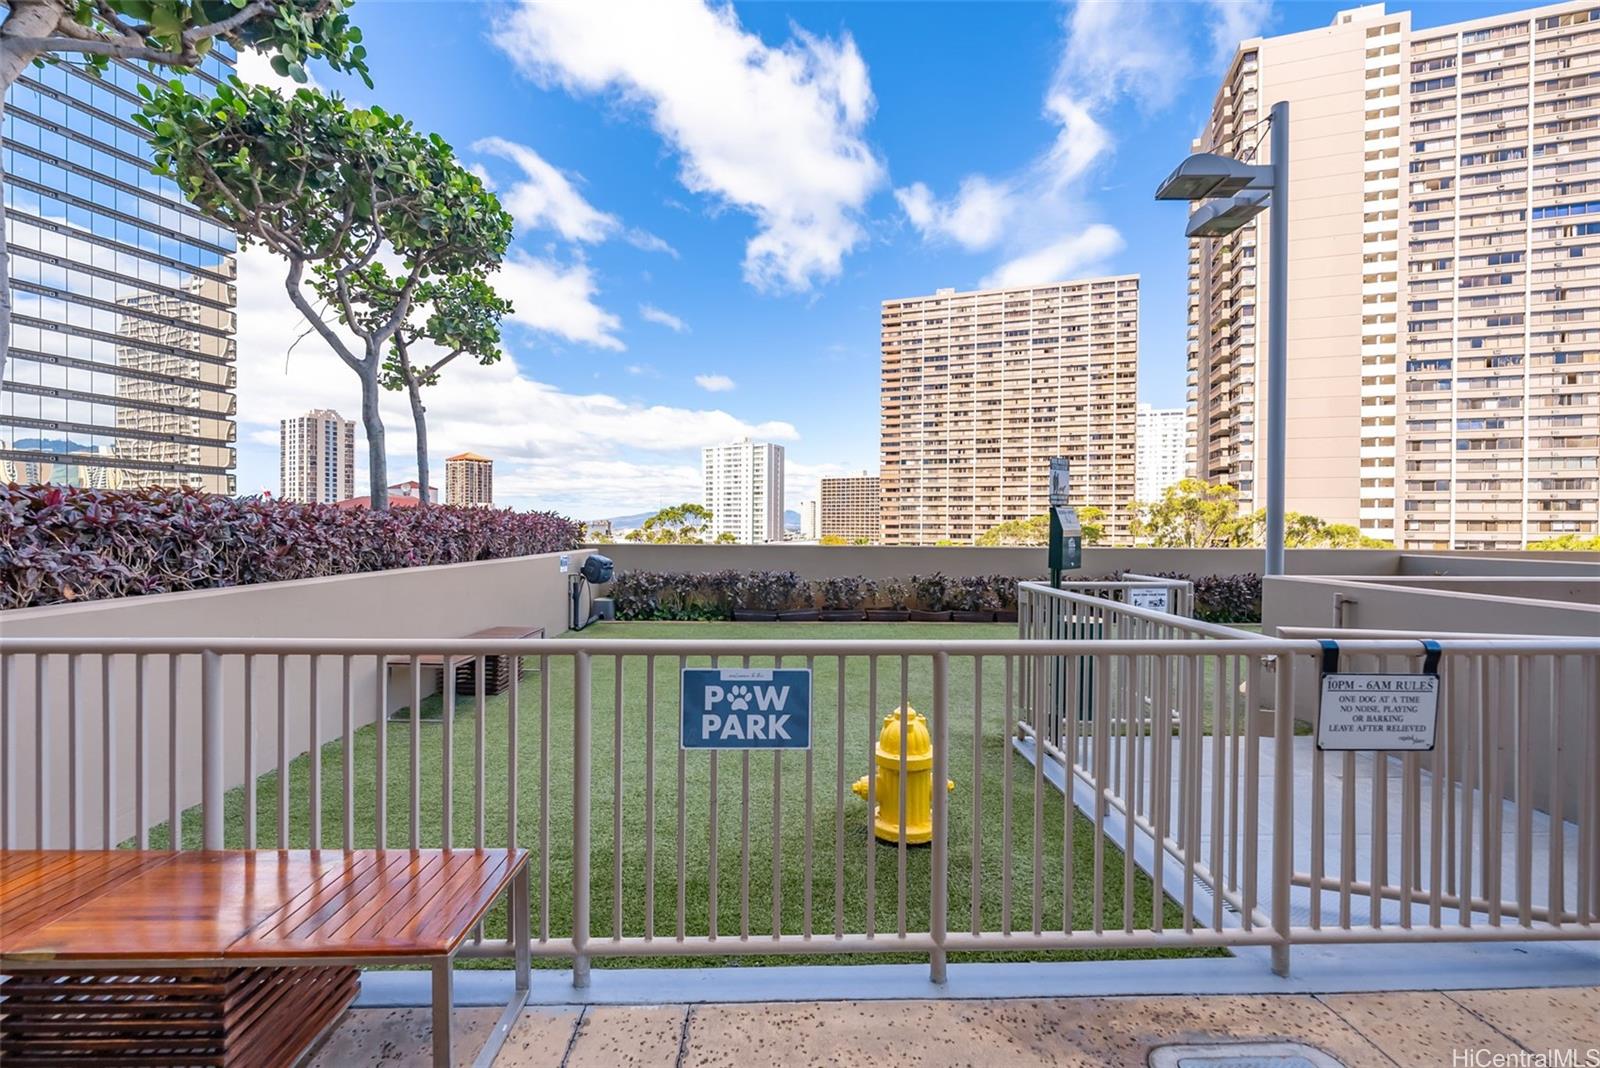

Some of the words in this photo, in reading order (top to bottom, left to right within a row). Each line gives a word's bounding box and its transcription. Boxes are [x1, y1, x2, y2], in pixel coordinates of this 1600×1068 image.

[1328, 680, 1354, 689] 10PM
[1366, 680, 1391, 689] 6AM
[1396, 681, 1434, 690] RULES
[1339, 695, 1356, 703] ONE
[1359, 695, 1376, 703] DOG
[1379, 695, 1390, 703] AT
[1391, 695, 1398, 703] A
[1400, 695, 1420, 703] TIME
[1340, 705, 1353, 713] NO
[1355, 705, 1380, 713] NOISE,
[1383, 705, 1418, 713] PLAYING
[702, 714, 792, 740] PARK
[1328, 724, 1354, 732] LEAVE
[1357, 724, 1384, 732] AFTER
[1386, 724, 1427, 732] RELIEVED
